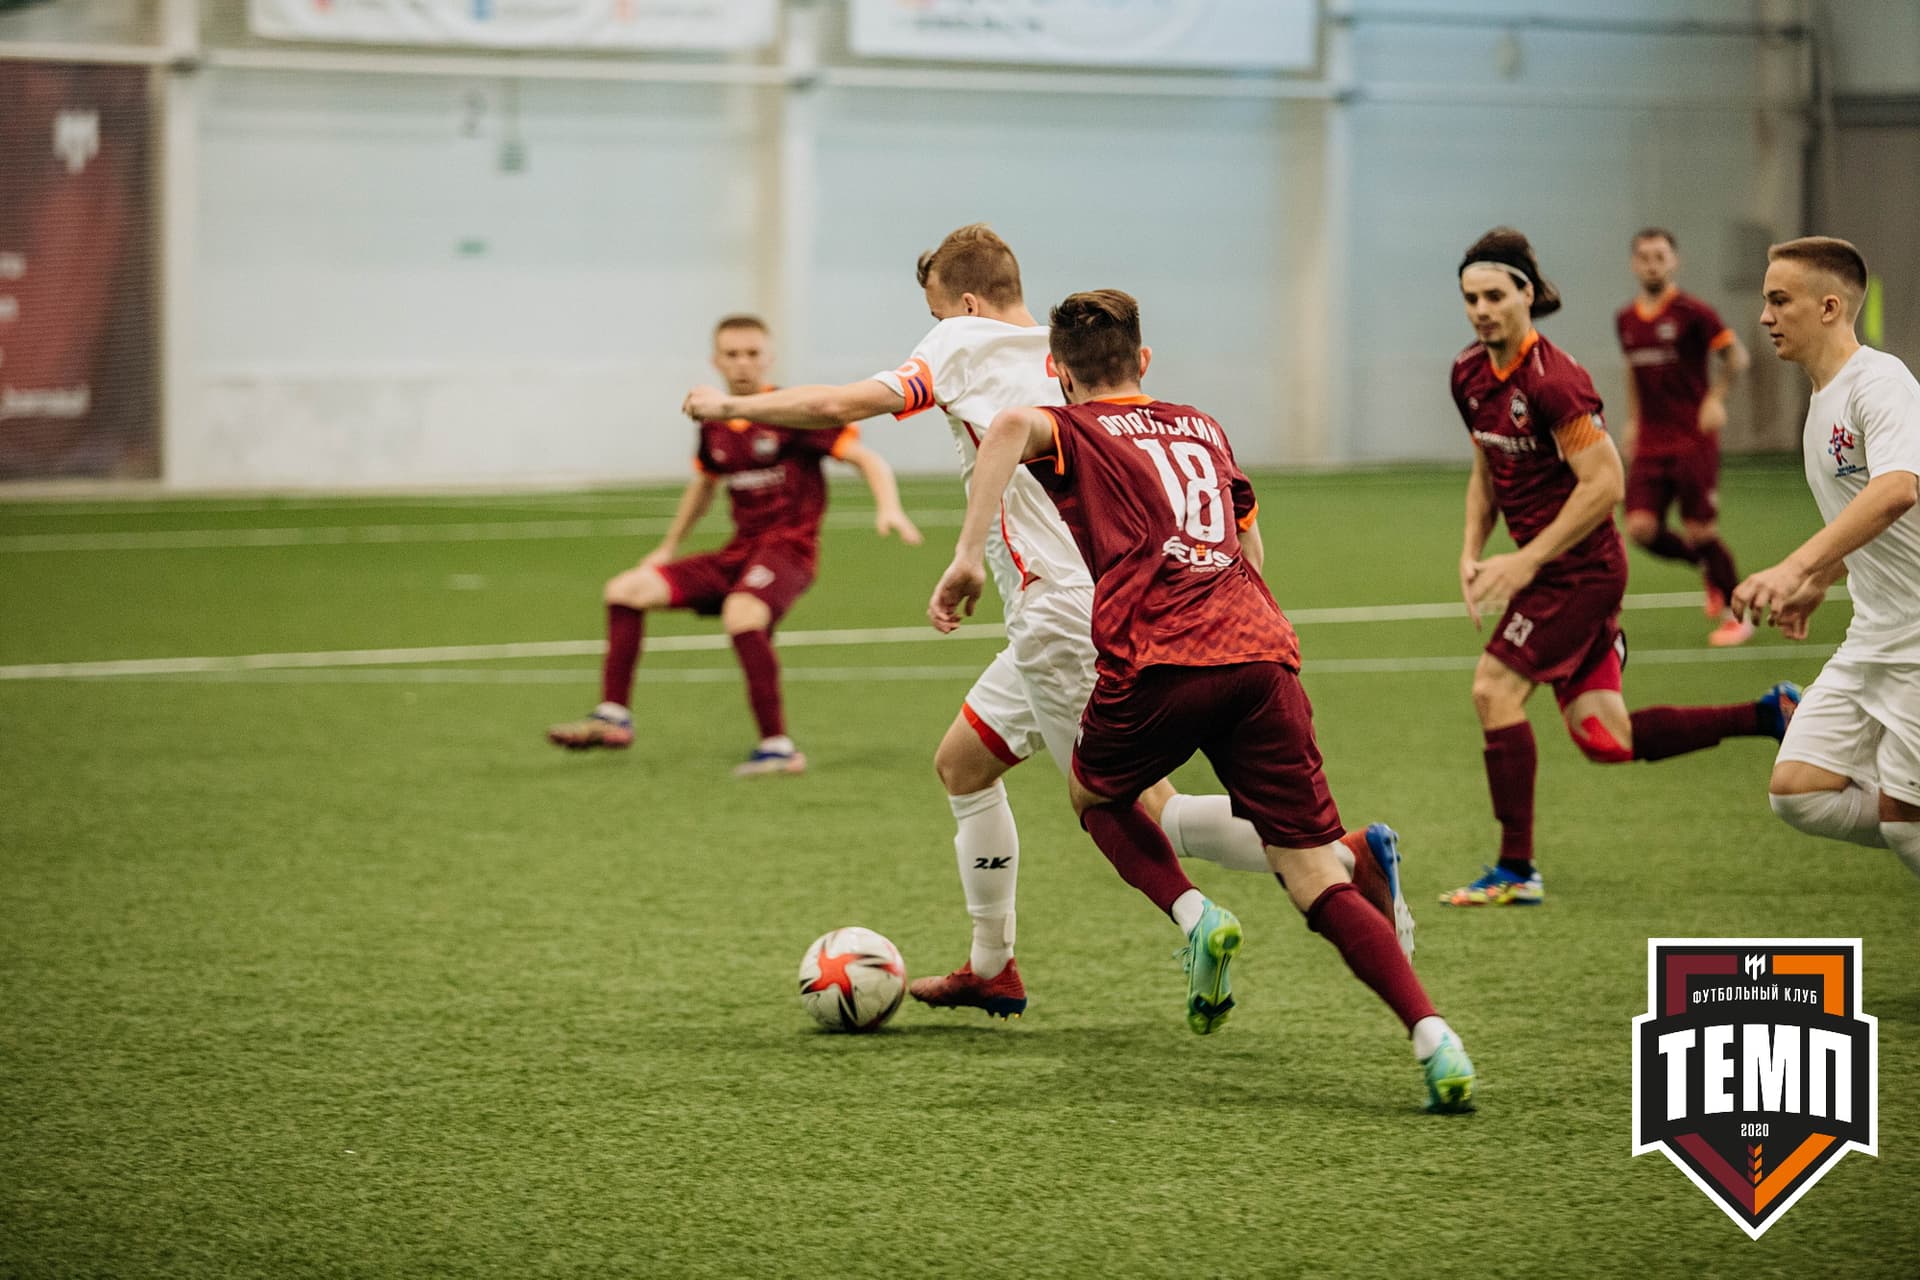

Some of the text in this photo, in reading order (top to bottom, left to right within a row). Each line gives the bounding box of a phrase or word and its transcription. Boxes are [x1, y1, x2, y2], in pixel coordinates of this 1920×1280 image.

[1133, 438, 1226, 544] 18
[1502, 611, 1535, 648] 23
[973, 856, 1013, 870] 2K
